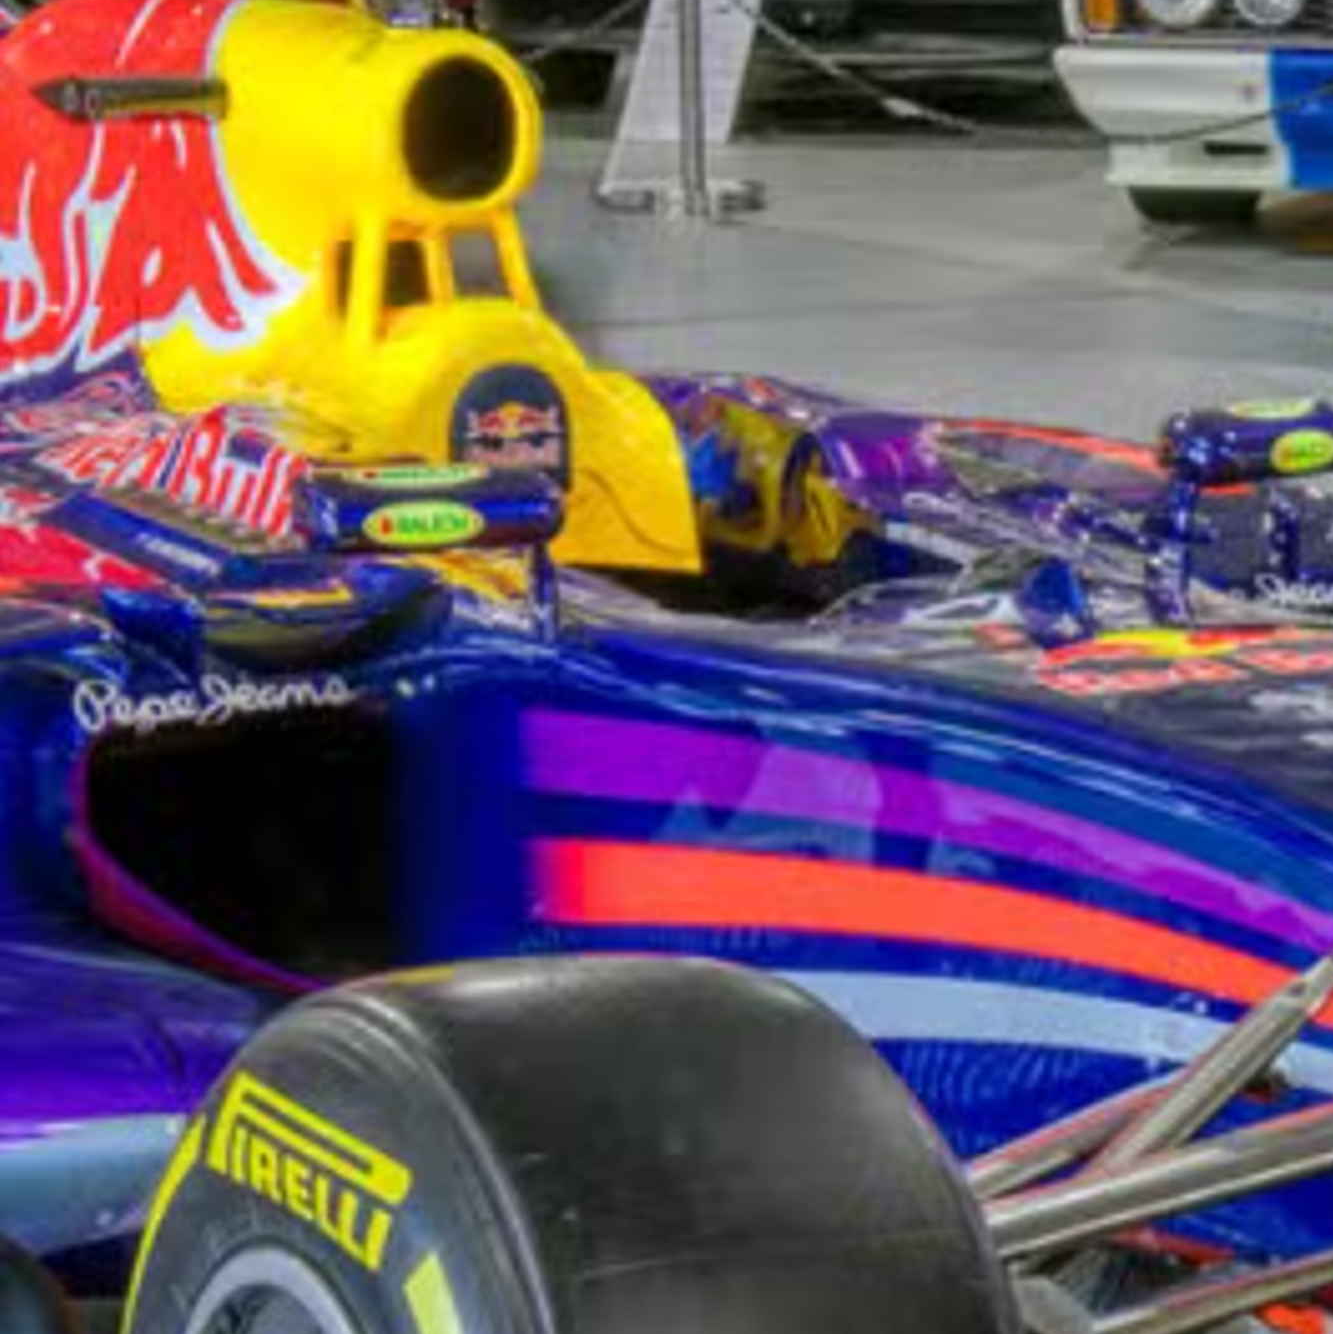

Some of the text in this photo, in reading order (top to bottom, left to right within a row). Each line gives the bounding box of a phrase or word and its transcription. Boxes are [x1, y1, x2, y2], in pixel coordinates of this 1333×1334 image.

[73, 670, 356, 735] Pepe Jeans
[206, 1071, 413, 1272] PIRELLI
